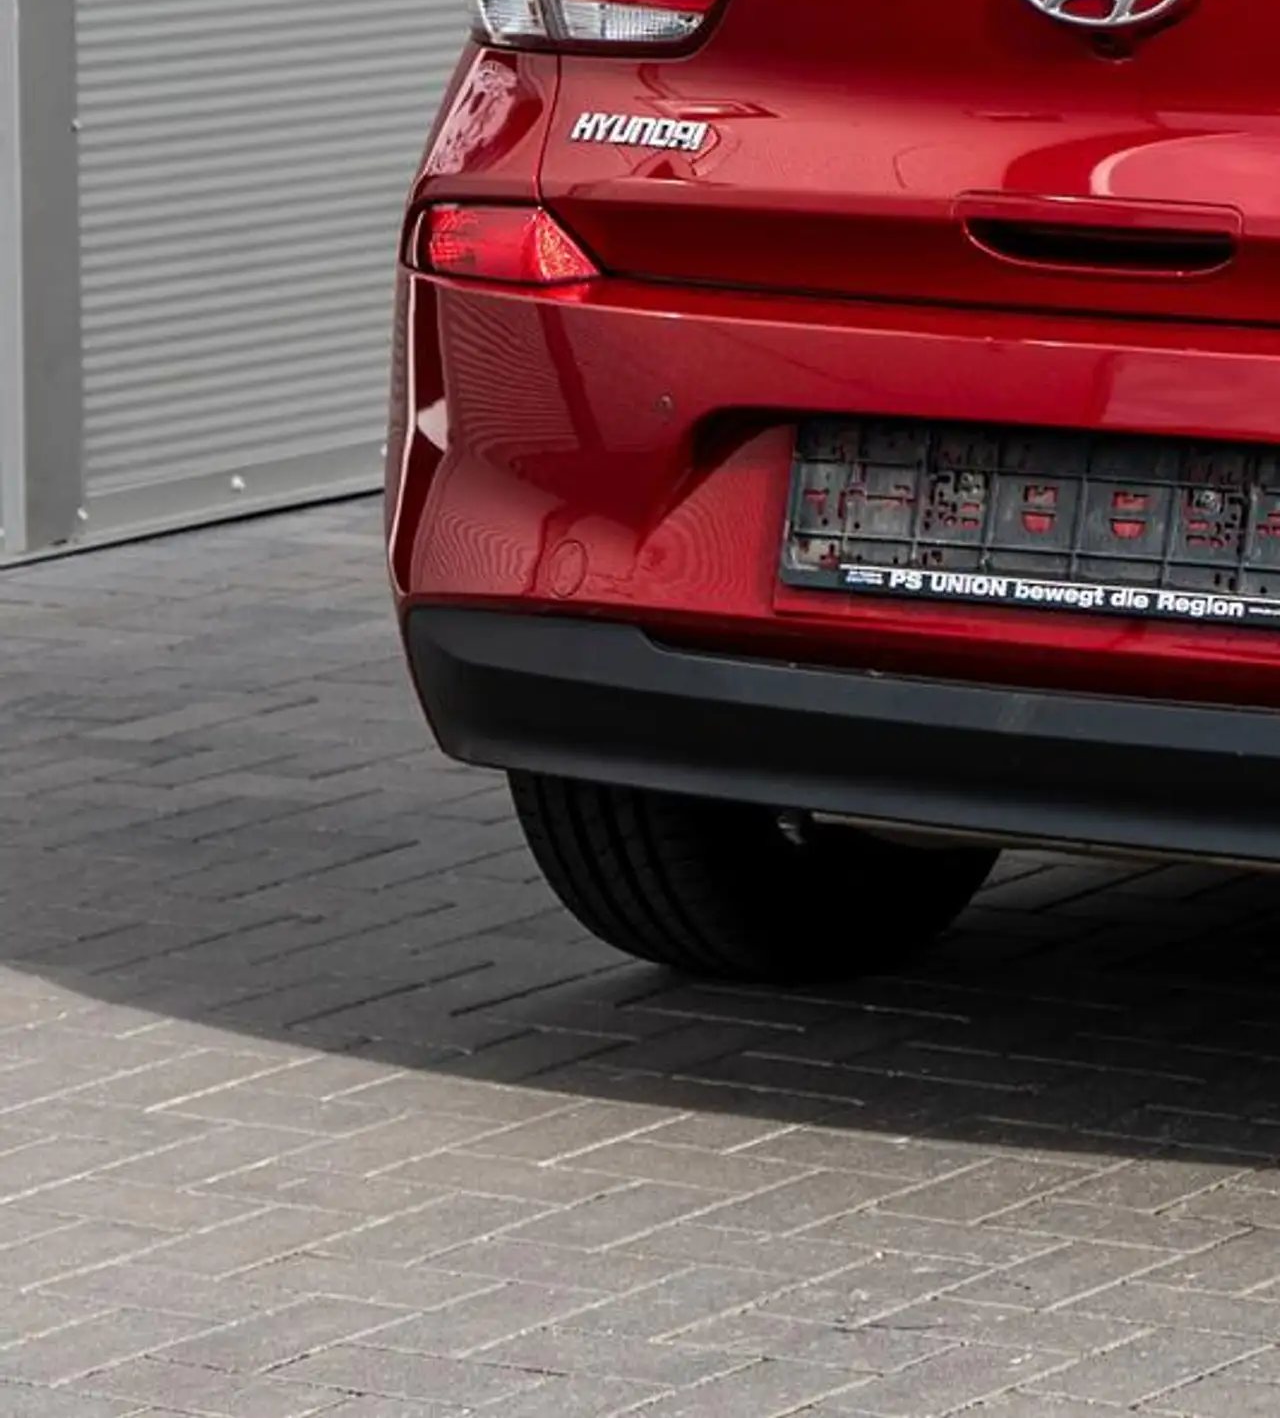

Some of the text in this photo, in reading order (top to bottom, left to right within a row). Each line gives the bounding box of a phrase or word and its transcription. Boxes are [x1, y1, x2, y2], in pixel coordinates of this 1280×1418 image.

[570, 112, 709, 151] HYUNDAI
[888, 570, 923, 591] PS
[930, 573, 1007, 597] UNION
[1014, 580, 1105, 608] bewegt
[1110, 588, 1150, 609] die
[1157, 592, 1245, 618] Region
